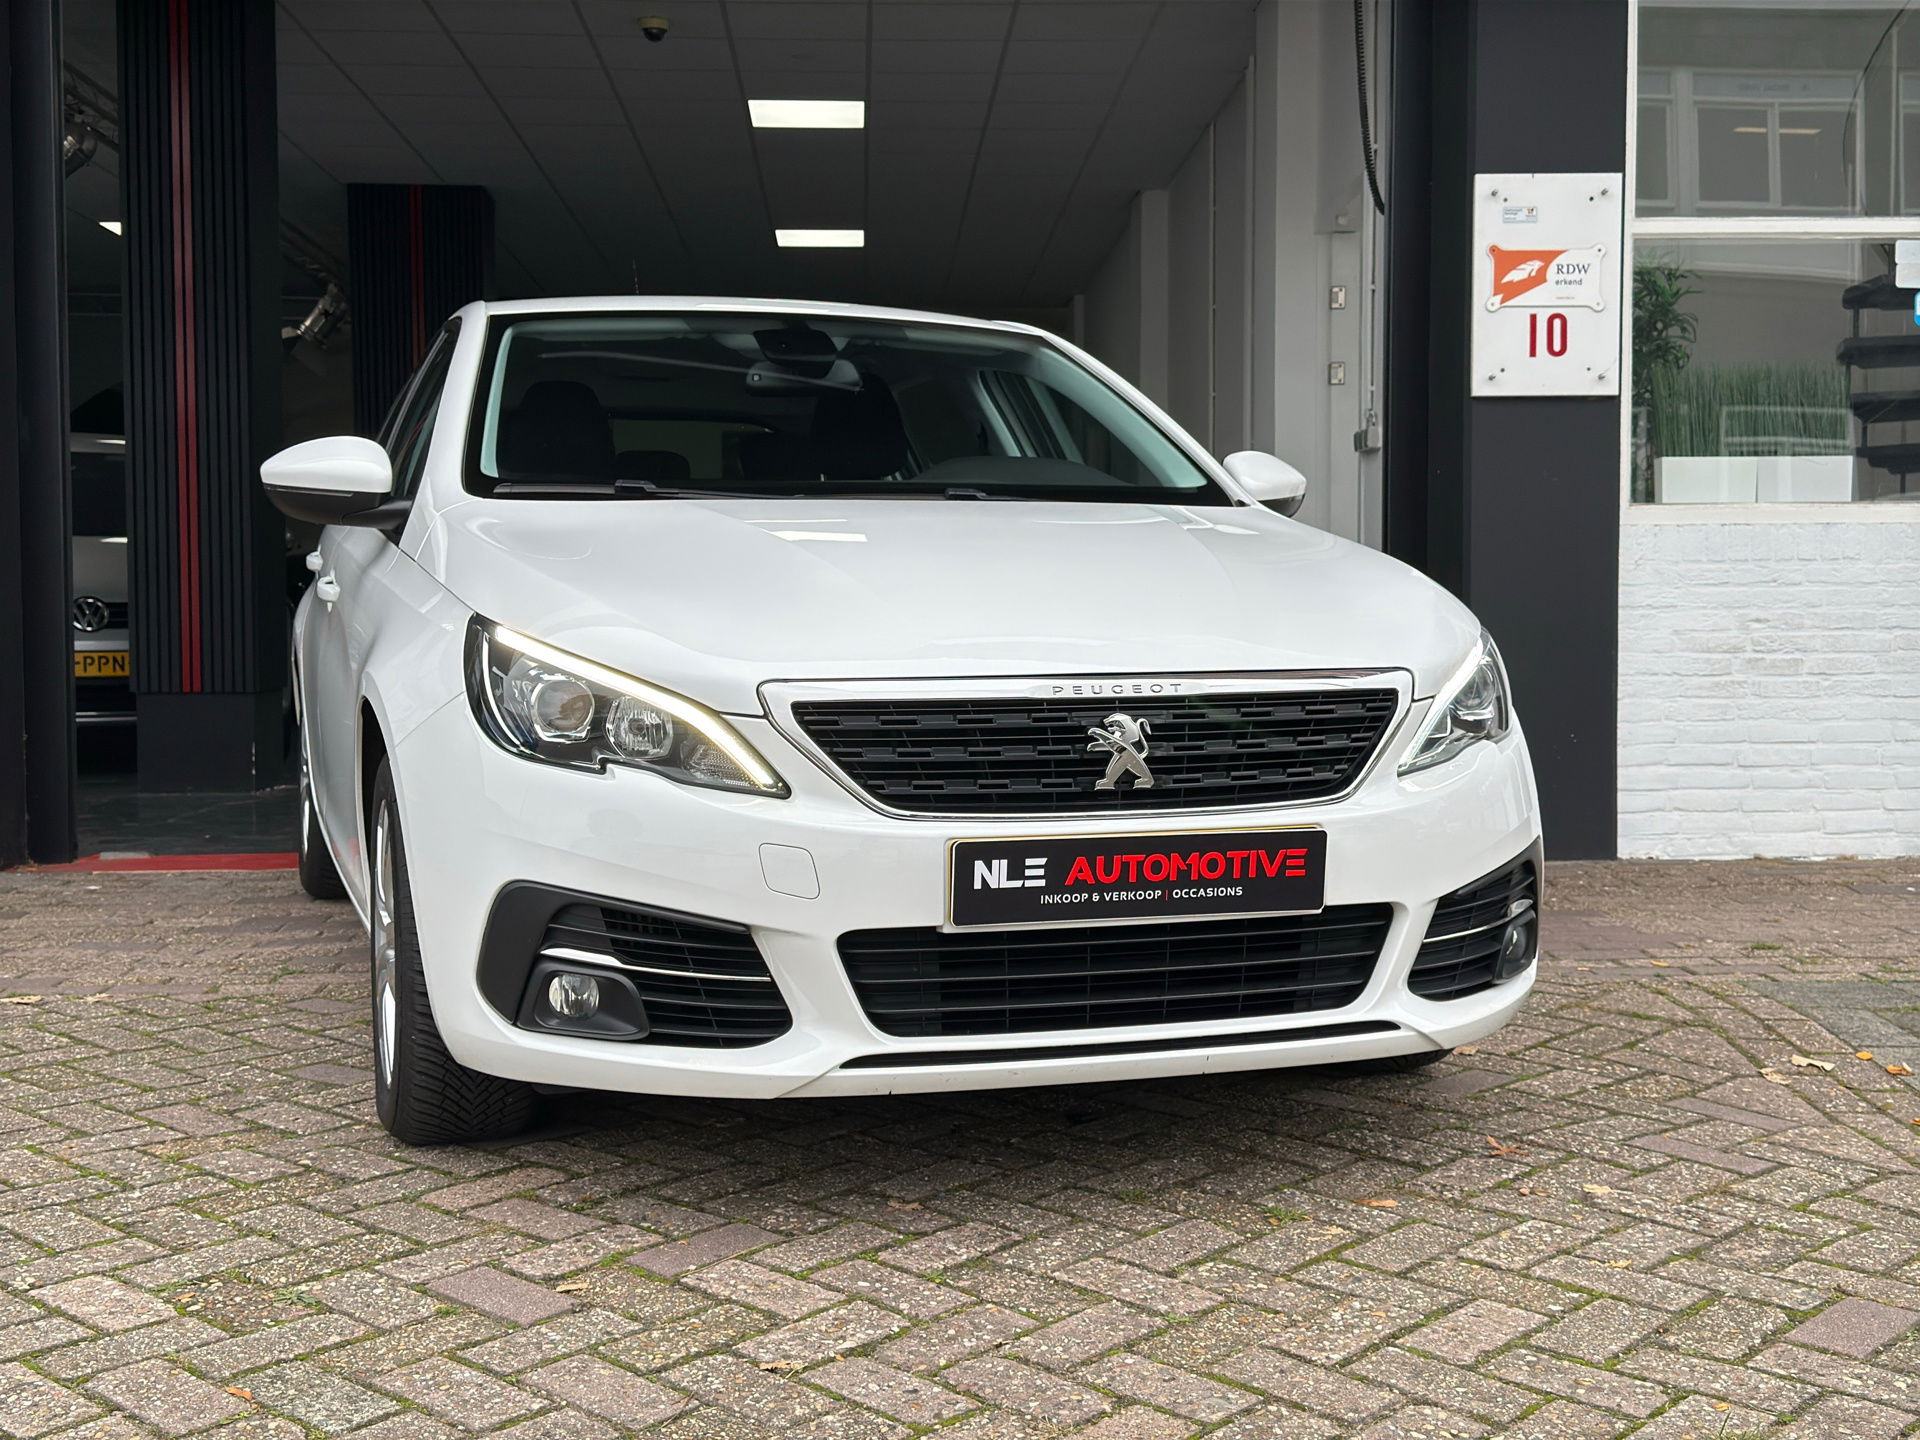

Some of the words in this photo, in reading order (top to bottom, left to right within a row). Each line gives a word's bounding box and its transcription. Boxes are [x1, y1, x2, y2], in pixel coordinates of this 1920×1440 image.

[1556, 263, 1591, 275] RDW
[1555, 278, 1583, 286] erkend
[1529, 312, 1567, 358] 10
[1052, 683, 1182, 695] PEUGEOT
[973, 857, 1048, 890] NLE
[1064, 848, 1309, 887] AUTOMOTIVE
[1040, 892, 1089, 905] INKOOP
[1092, 892, 1099, 902] &
[1103, 889, 1162, 902] VERKOOP
[1172, 886, 1243, 899] OCCASIONS
